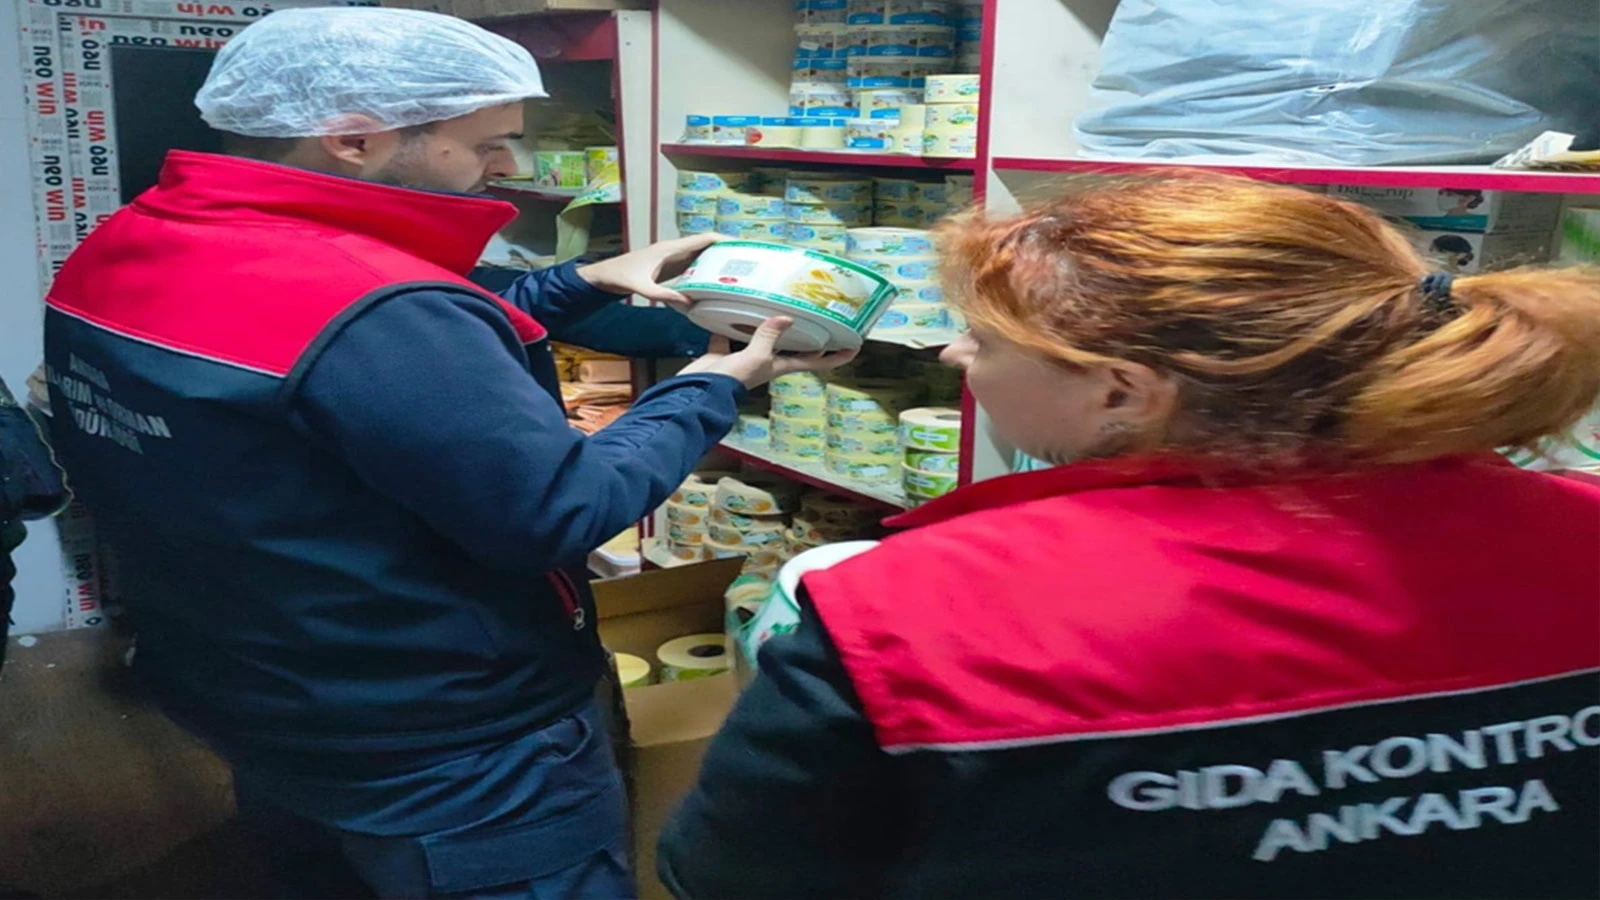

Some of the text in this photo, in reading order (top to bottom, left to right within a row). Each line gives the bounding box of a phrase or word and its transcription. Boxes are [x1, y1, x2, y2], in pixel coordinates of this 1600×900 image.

[112, 35, 167, 46] neo
[180, 25, 234, 37] neo
[33, 46, 54, 78] neo
[81, 39, 101, 70] neo
[36, 81, 59, 115] win
[83, 110, 106, 142] win
[42, 155, 63, 186] neo
[89, 145, 109, 176] neo
[46, 189, 68, 221] win
[1106, 758, 1321, 812] GIDA
[1252, 779, 1561, 862] ANKARA
